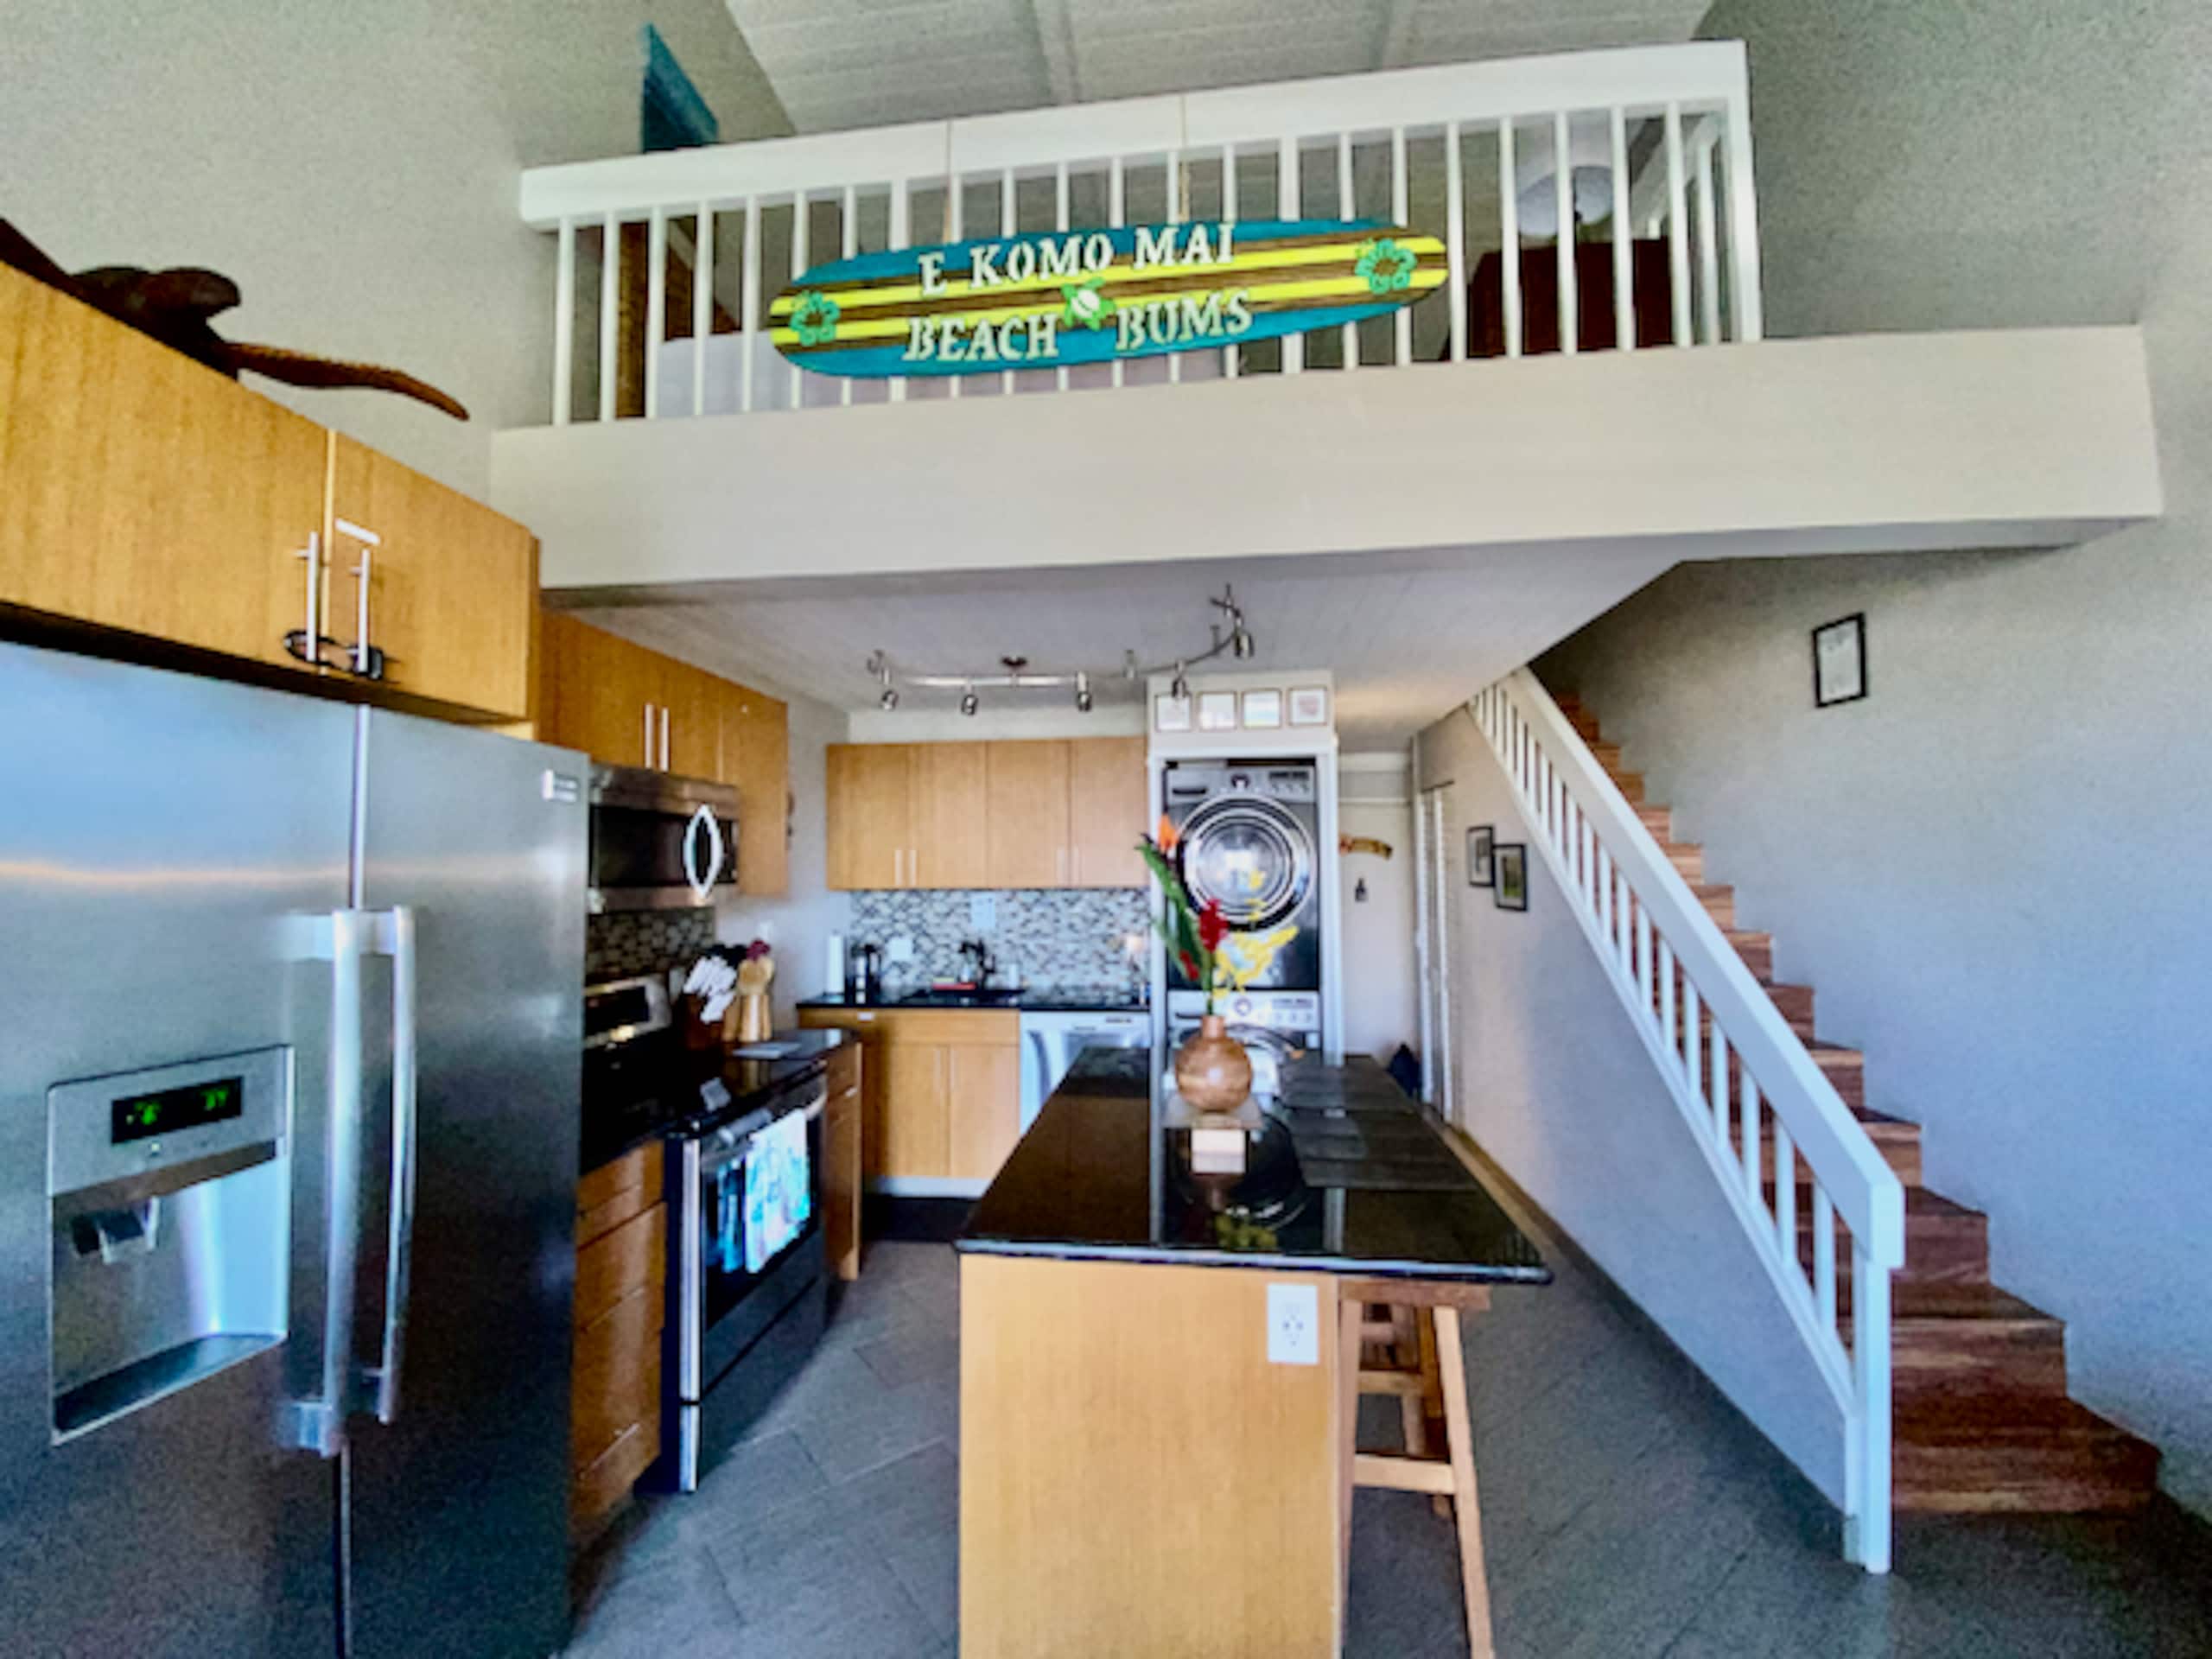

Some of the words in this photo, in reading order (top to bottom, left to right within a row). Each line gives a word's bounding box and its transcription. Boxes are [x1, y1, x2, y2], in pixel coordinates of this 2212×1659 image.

[918, 251, 948, 296] E
[969, 232, 1115, 289] KOMO
[1133, 223, 1236, 270] MAI
[901, 313, 1060, 362] BEACH
[1116, 290, 1253, 351] BUMS
